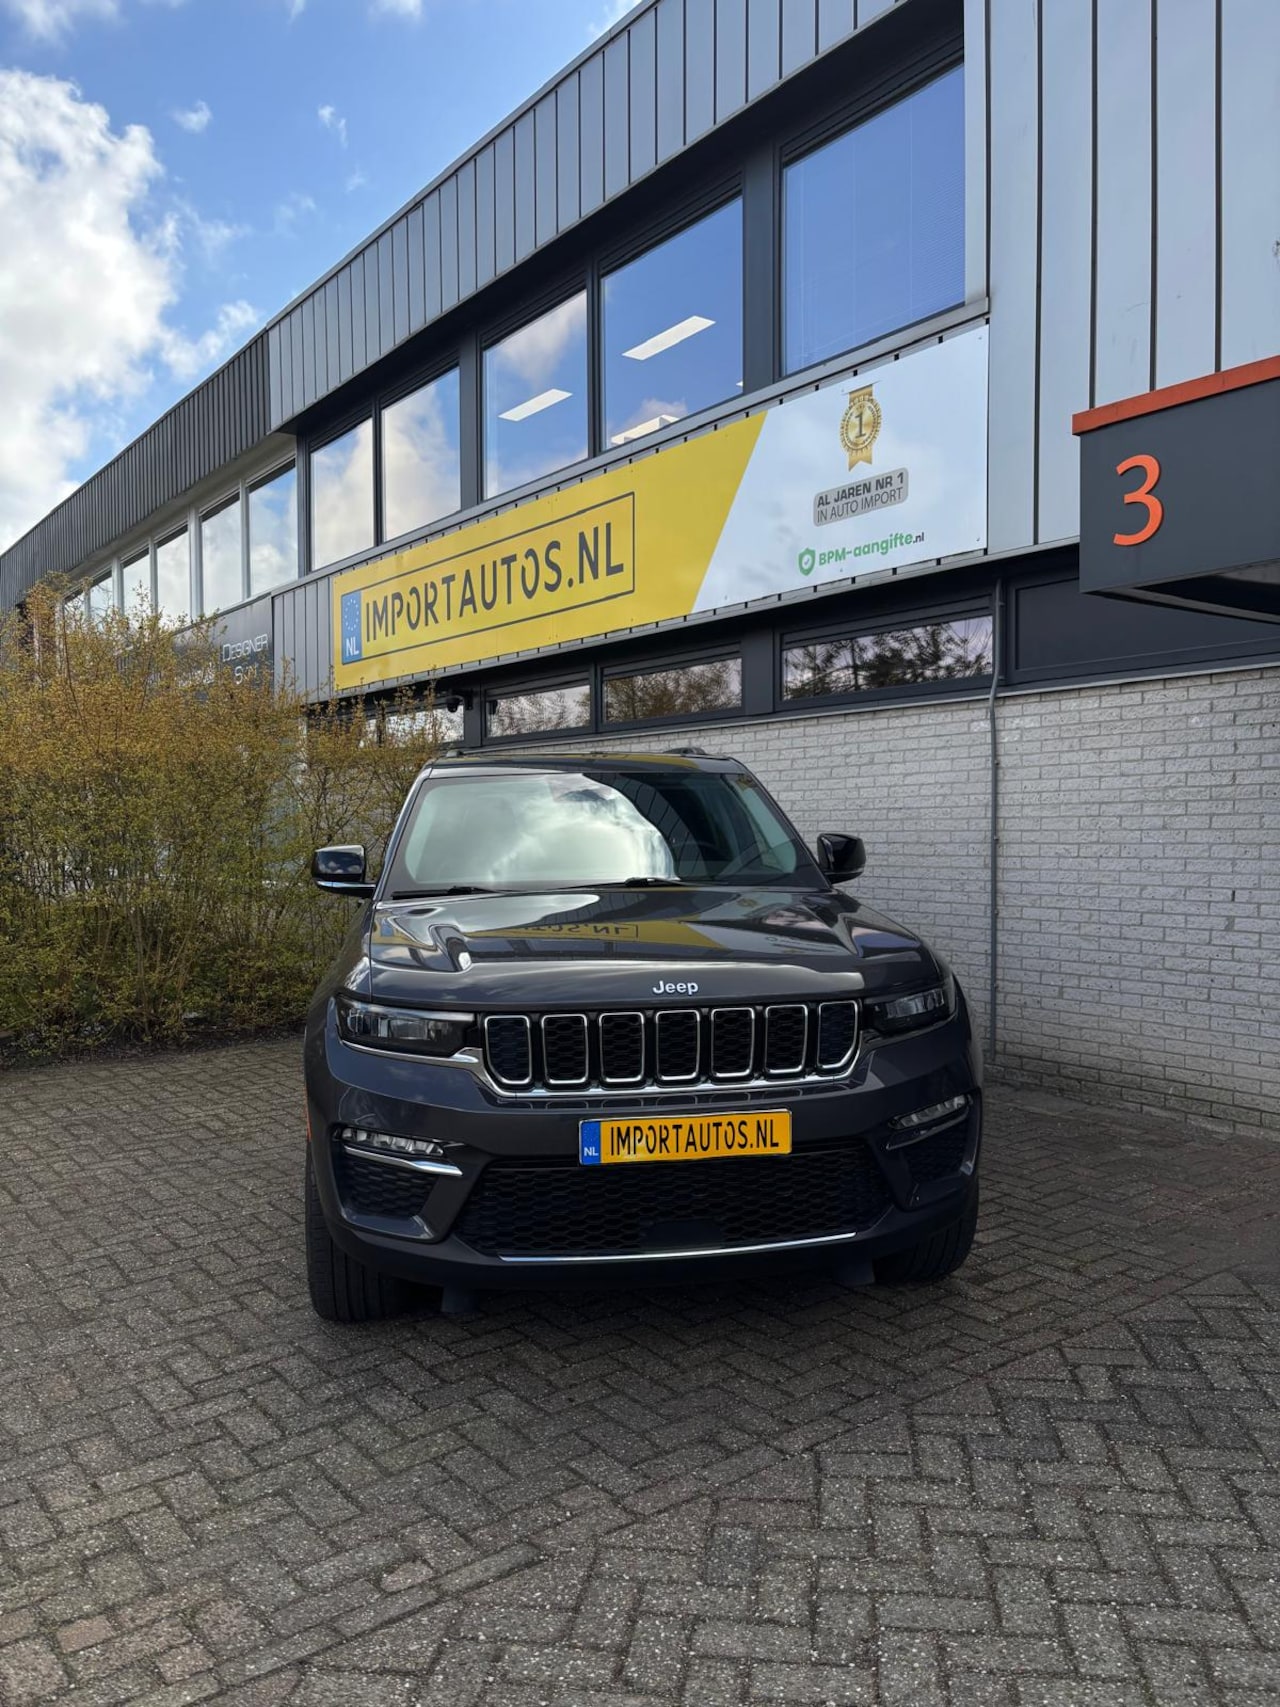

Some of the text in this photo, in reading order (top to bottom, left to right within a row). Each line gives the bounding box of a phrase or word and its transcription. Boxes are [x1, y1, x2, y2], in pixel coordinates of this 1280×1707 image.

[855, 411, 866, 438] 1
[817, 472, 904, 508] AL JAREN NR 1
[817, 487, 904, 523] IN AUTO IMPORT
[1113, 453, 1164, 546] 3
[818, 531, 925, 566] BPM-aangifte.nl
[366, 521, 625, 643] IMPORTAUTOS.NL
[222, 633, 269, 662] DESIGNER
[346, 636, 360, 657] NL
[652, 980, 699, 995] Jeep
[583, 1119, 779, 1157] NL IMPORTAUTOS.NL
